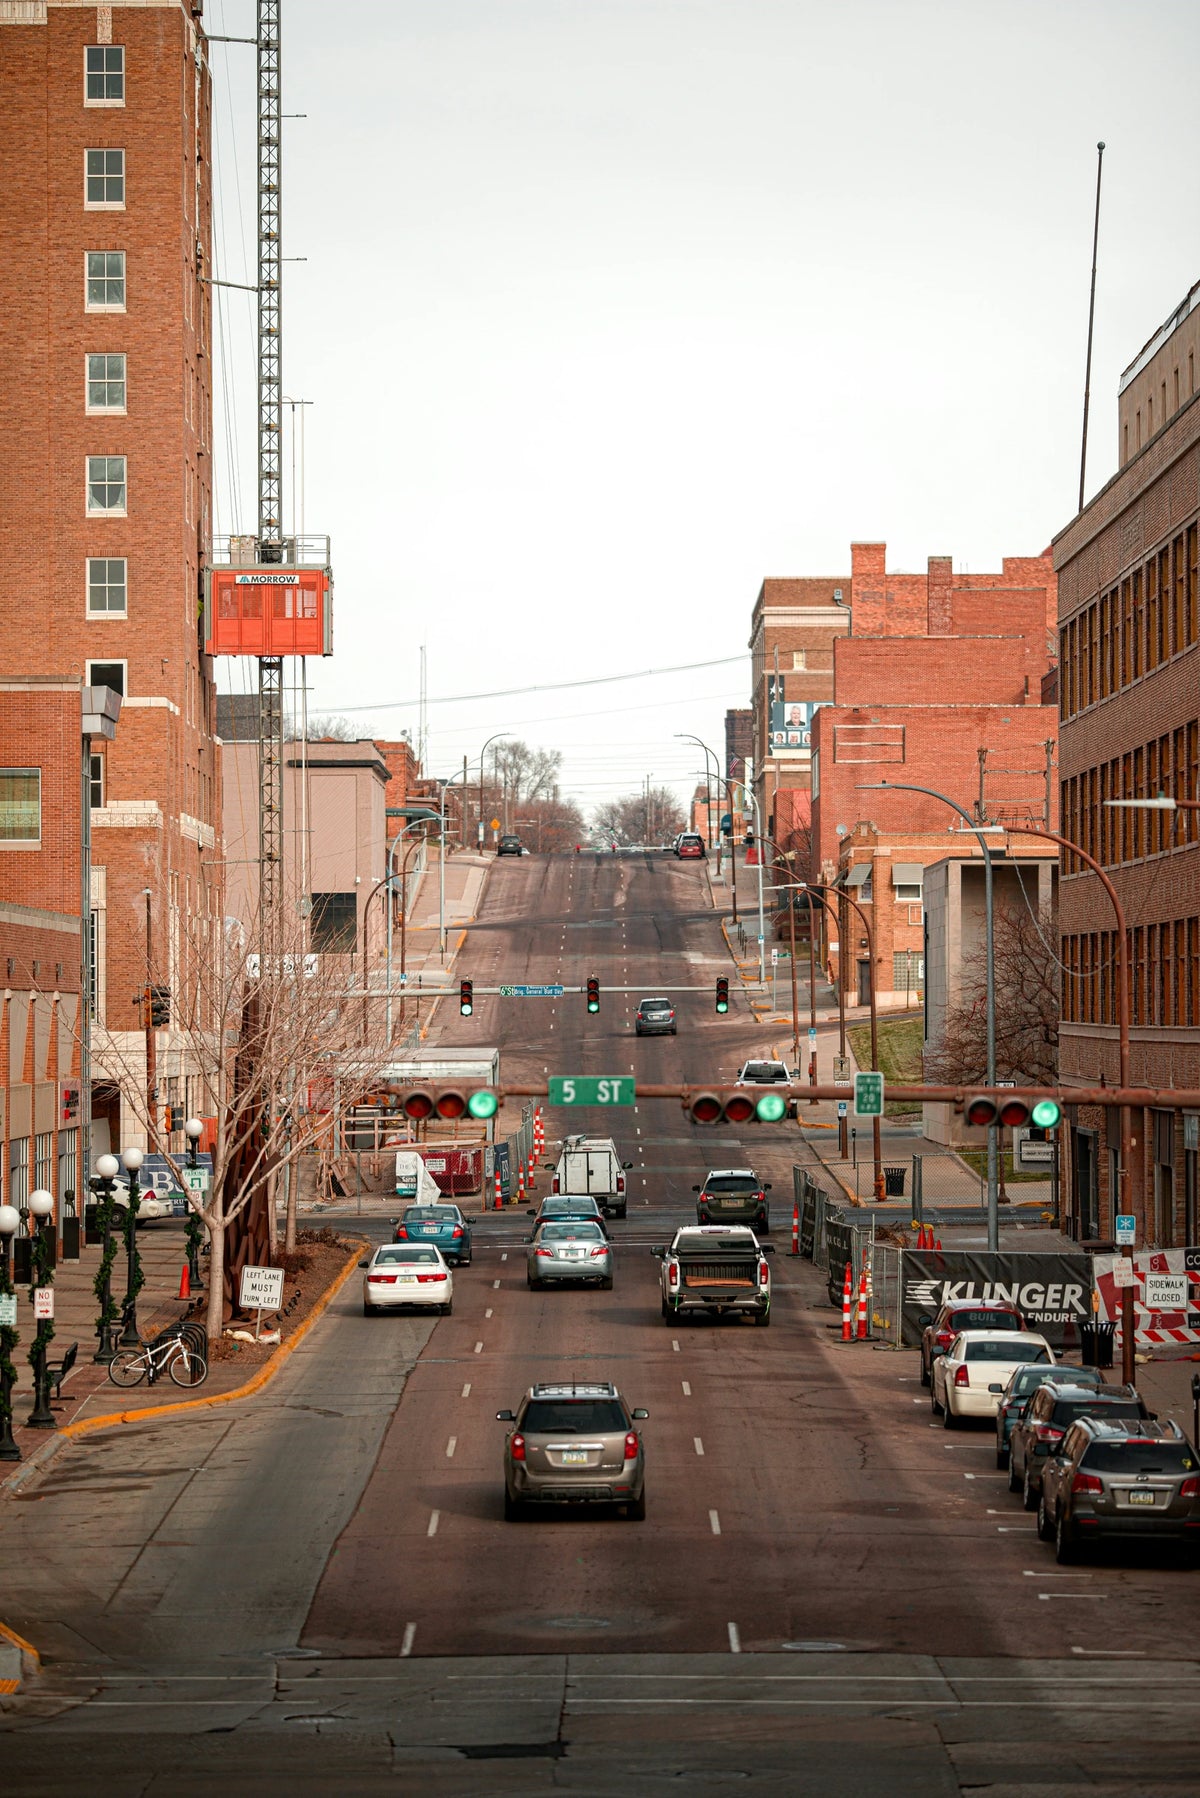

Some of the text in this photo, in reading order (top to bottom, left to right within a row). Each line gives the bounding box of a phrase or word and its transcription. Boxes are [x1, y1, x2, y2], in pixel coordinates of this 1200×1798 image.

[563, 1080, 622, 1103] 5 ST
[251, 1283, 272, 1292] MUST
[1149, 1280, 1184, 1289] SIDEWALK
[1153, 1293, 1181, 1302] CLOSED
[1028, 1313, 1078, 1322] ENDURE
